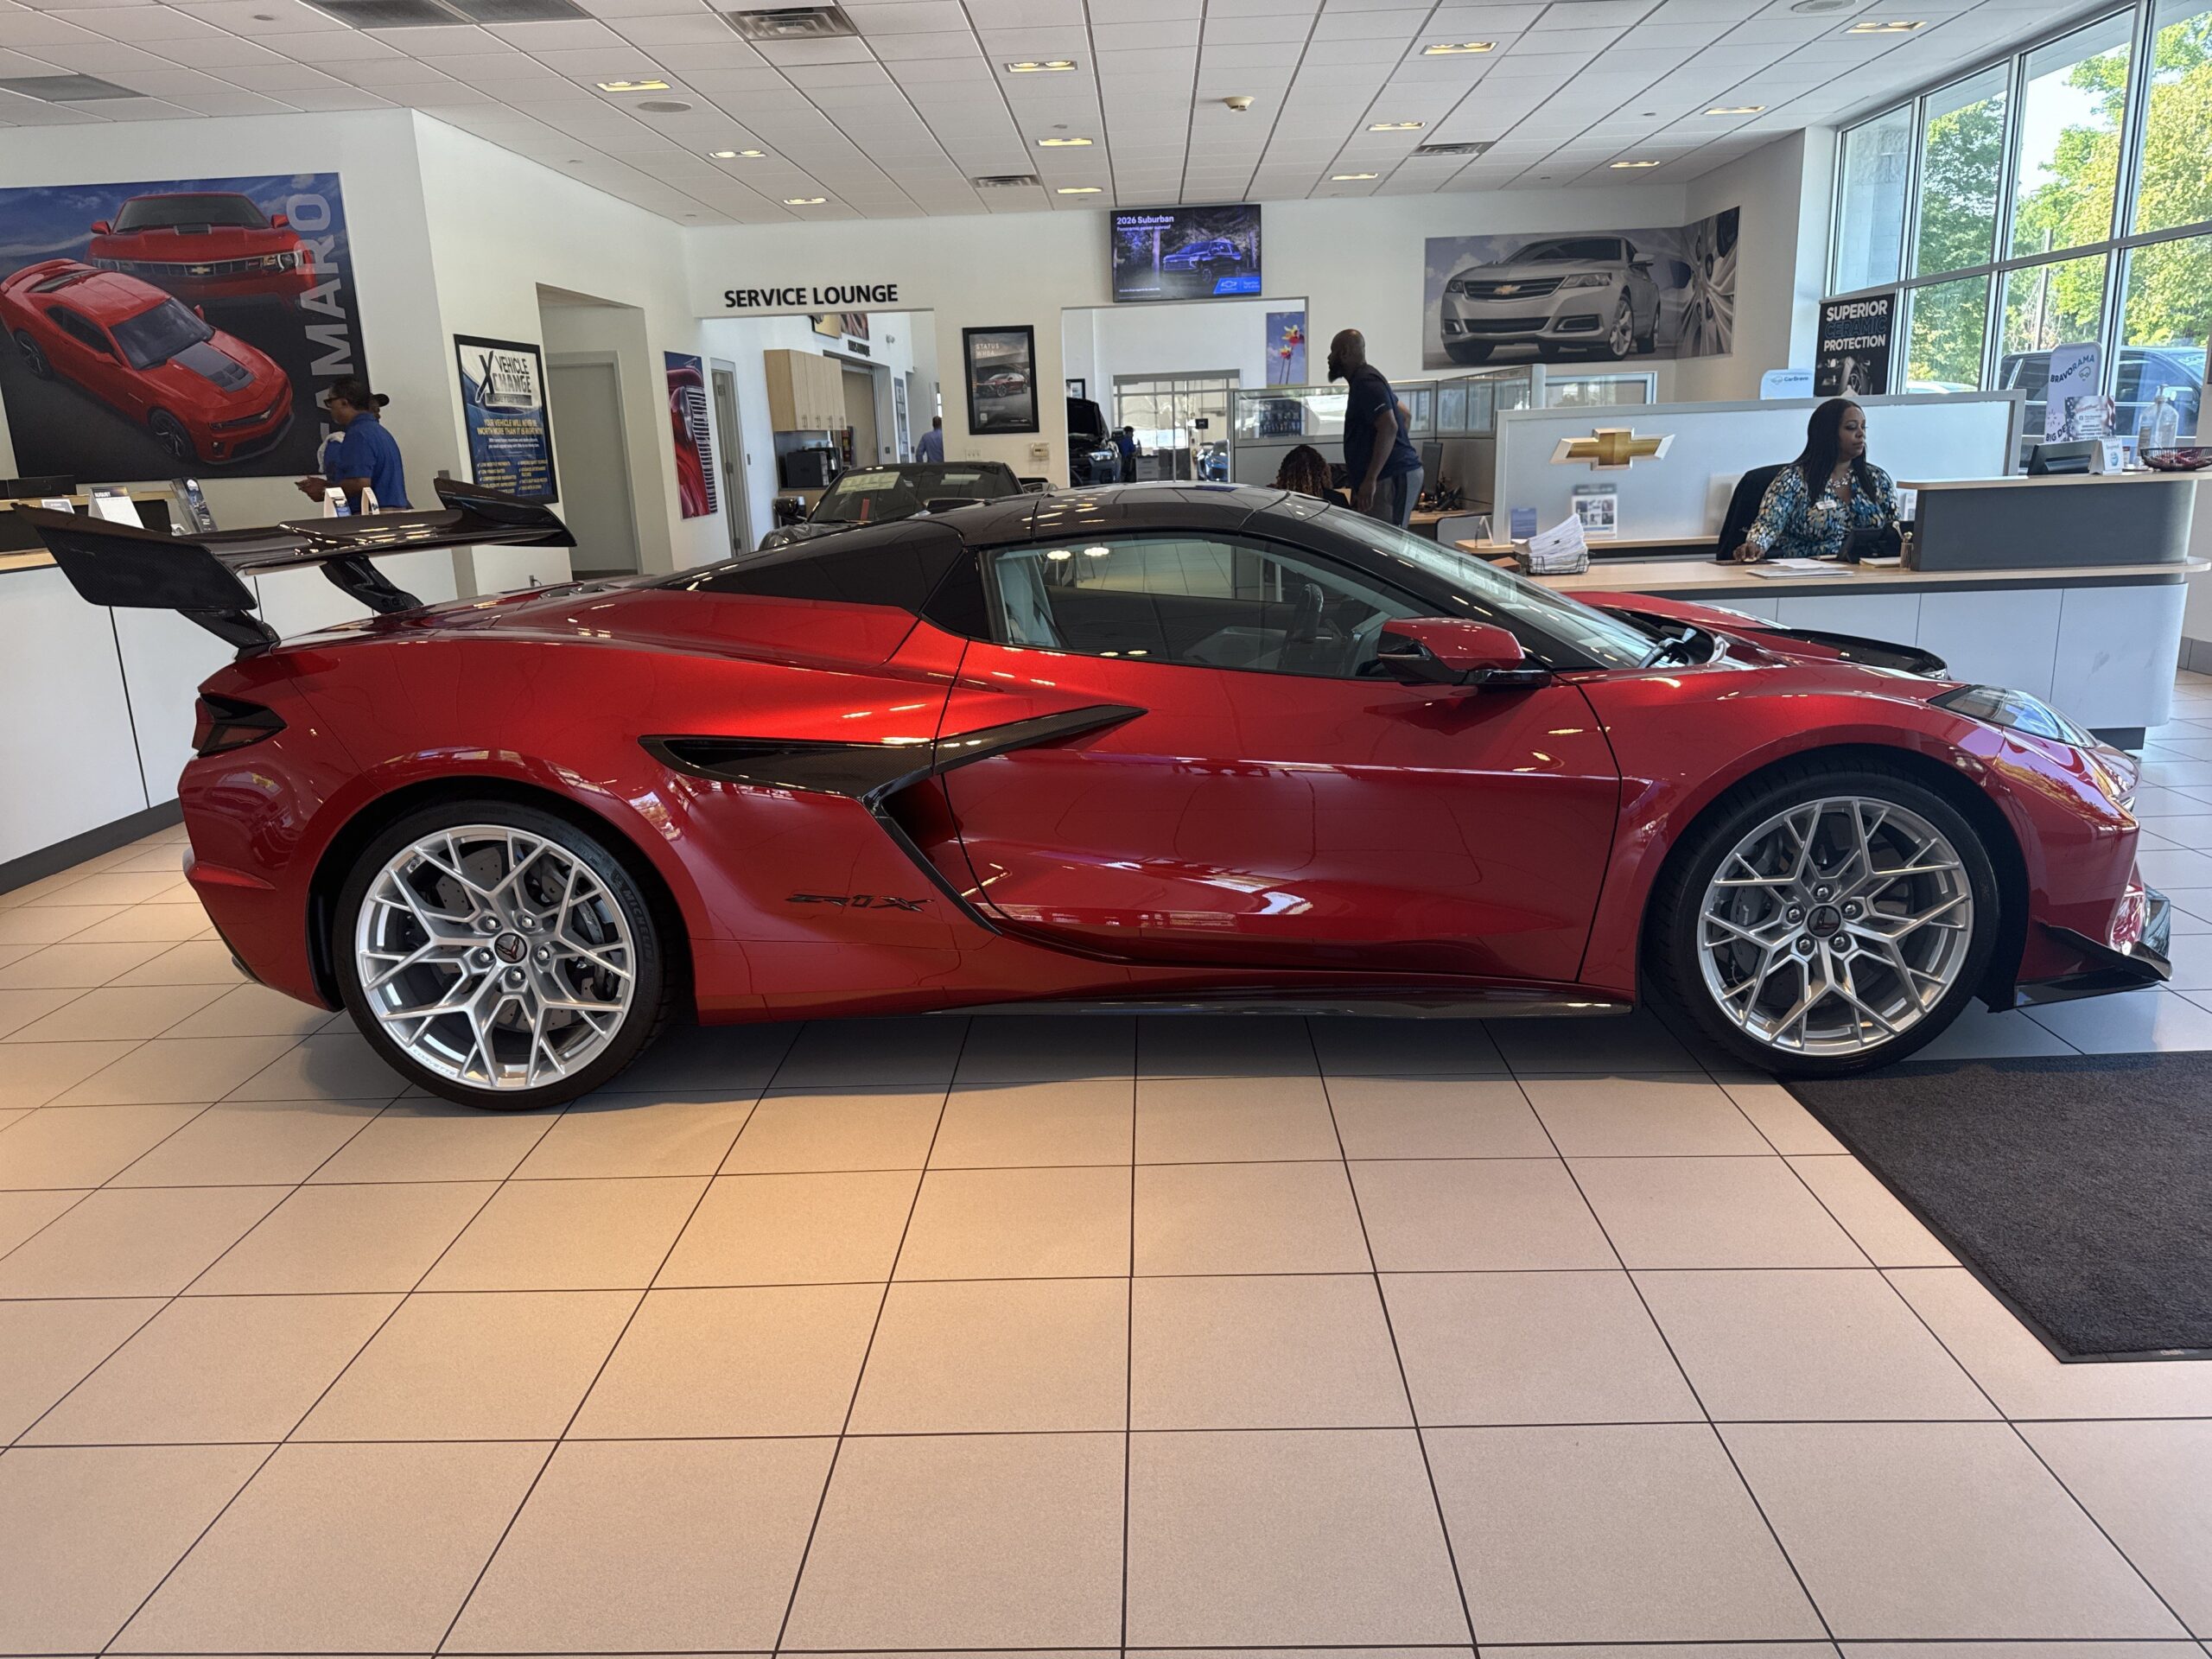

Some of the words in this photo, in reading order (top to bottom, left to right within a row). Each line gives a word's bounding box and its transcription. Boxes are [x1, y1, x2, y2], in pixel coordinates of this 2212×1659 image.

[1116, 216, 1136, 225] 2026
[1137, 215, 1174, 224] Suburban
[724, 288, 807, 308] SERVICE
[812, 284, 899, 305] LOUNGE
[1826, 300, 1888, 321] SUPERIOR
[1825, 315, 1888, 339] CERAMIC
[1823, 334, 1886, 352] PROTECTION
[494, 355, 530, 375] VEHICLE
[2050, 354, 2095, 383] BRAVORAMA
[505, 427, 516, 435] THAN
[2045, 433, 2056, 442] BIG
[622, 890, 655, 968] MICHELIN
